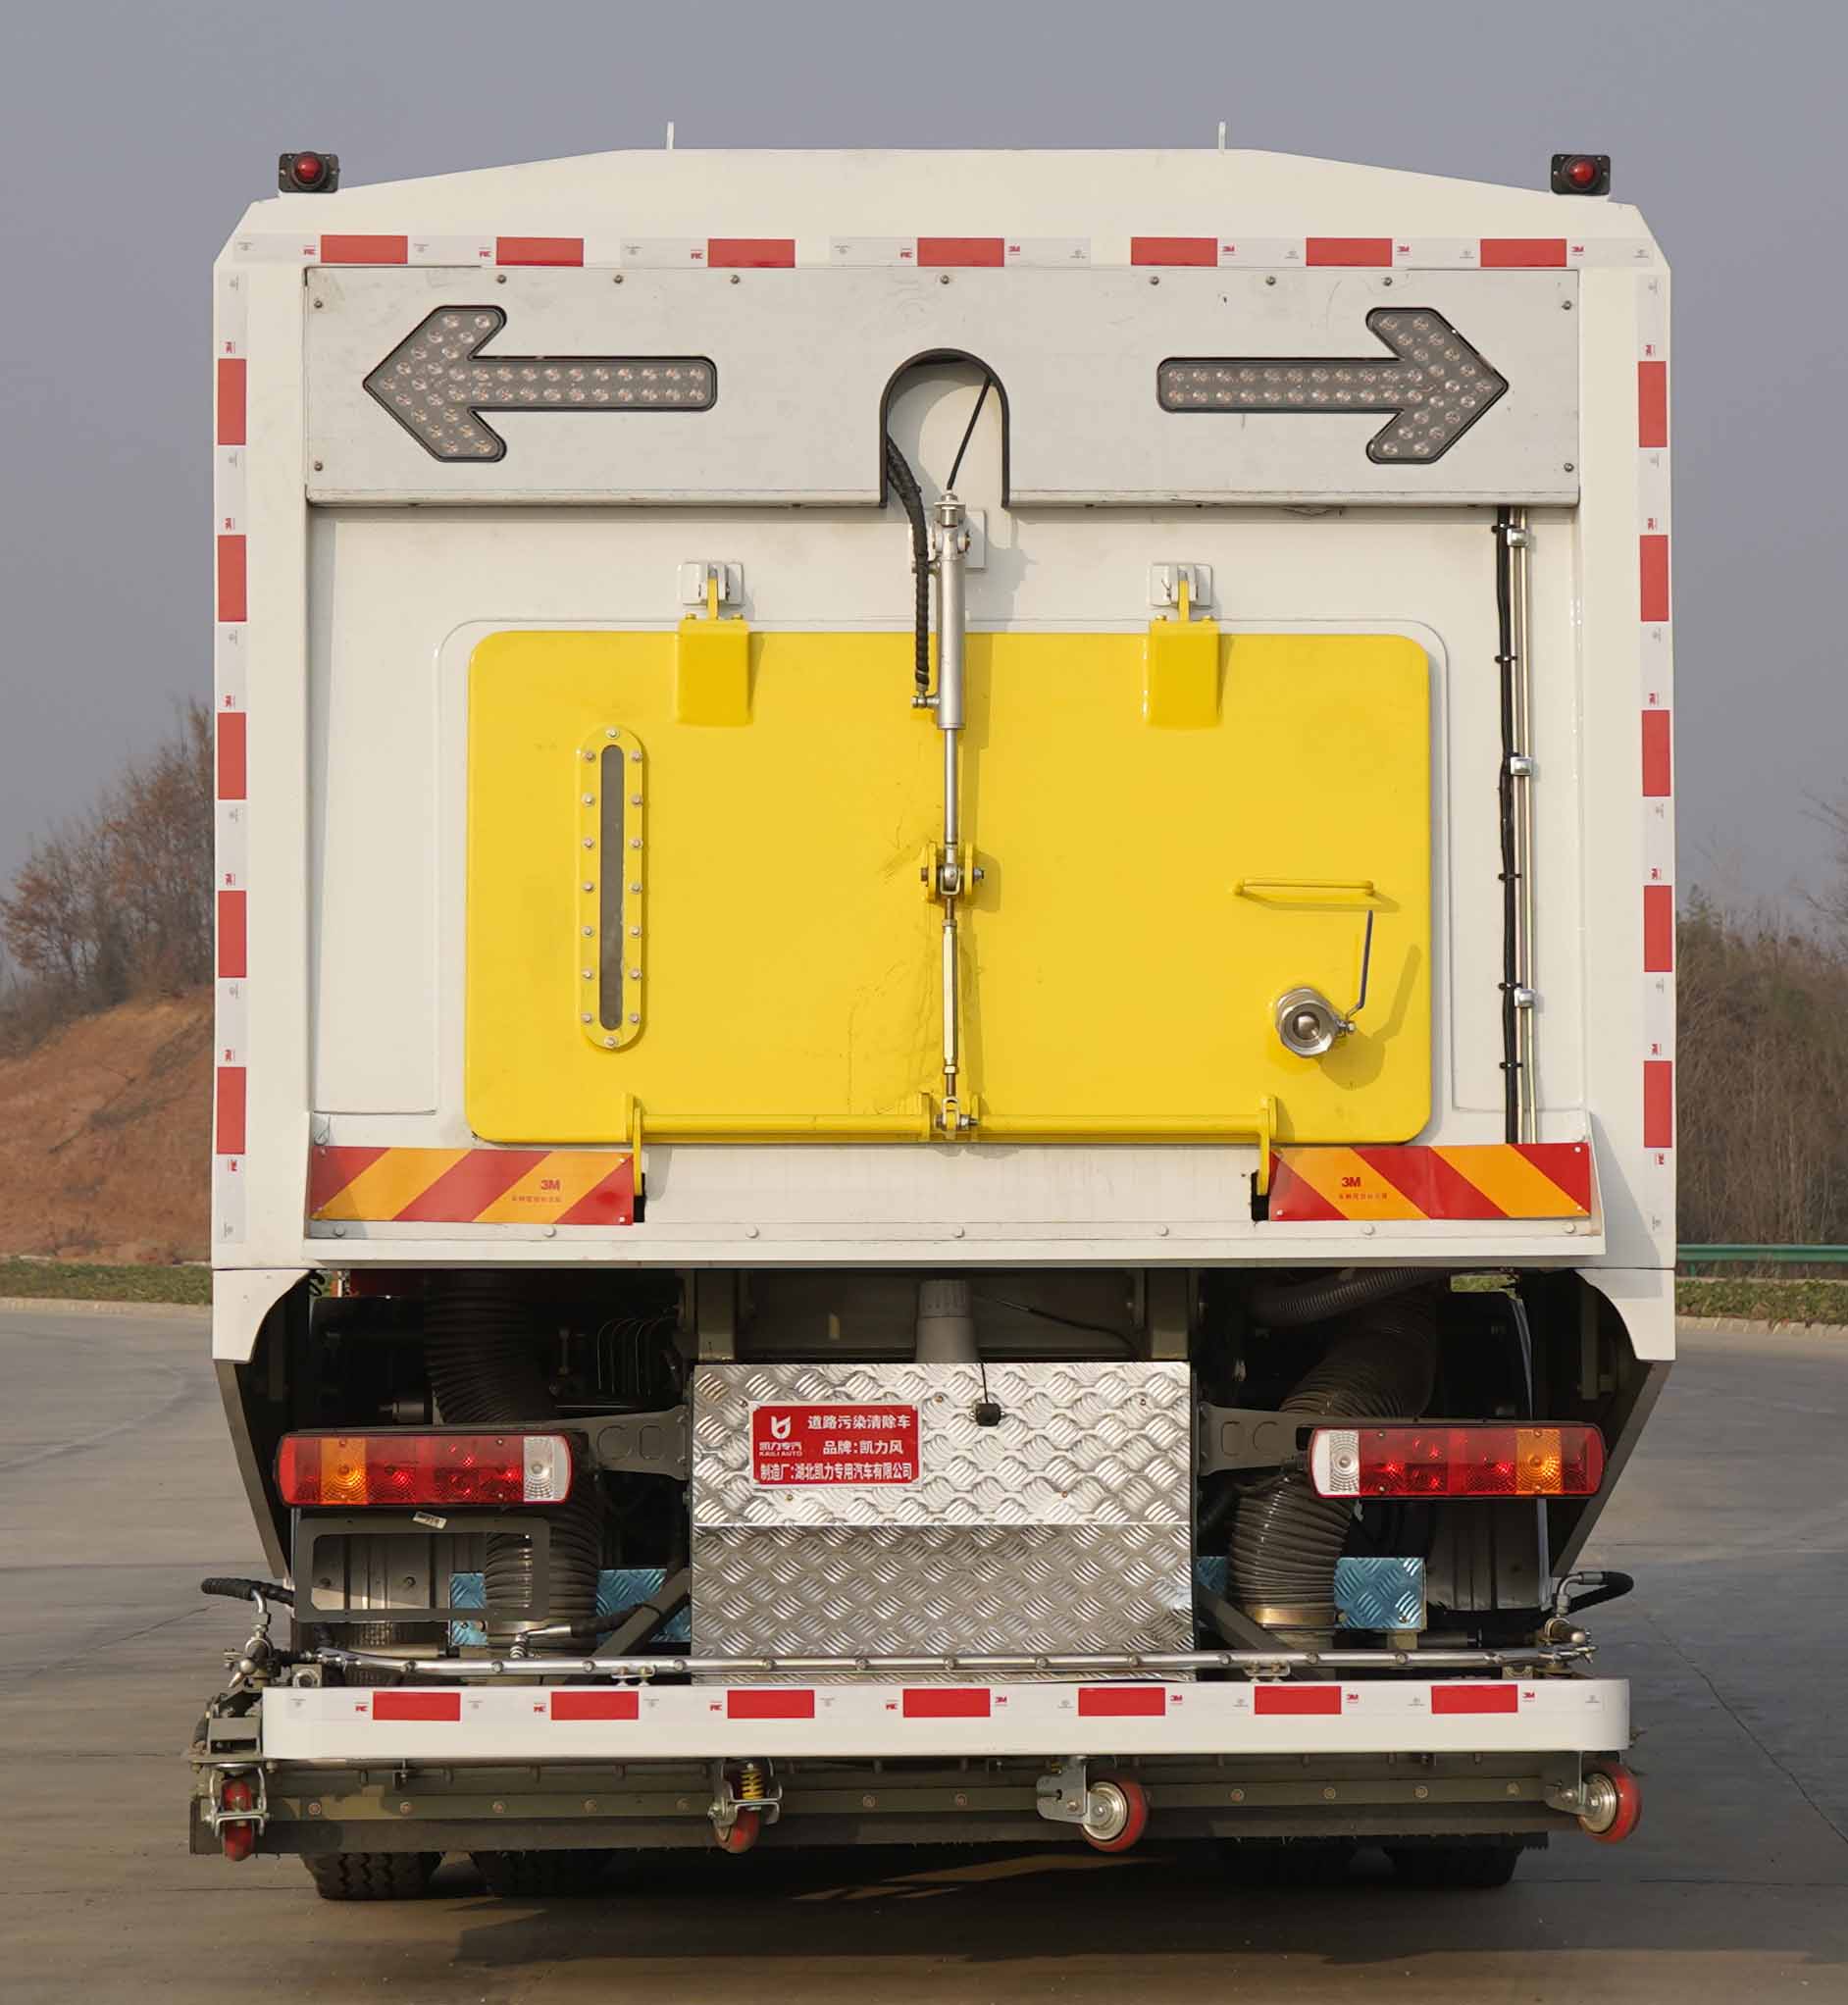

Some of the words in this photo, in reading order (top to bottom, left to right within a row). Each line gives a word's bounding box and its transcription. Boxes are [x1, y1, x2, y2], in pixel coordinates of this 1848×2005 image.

[540, 1180, 560, 1191] 3M
[1341, 1177, 1361, 1188] 3M
[807, 1414, 911, 1430] 道路污染清除车
